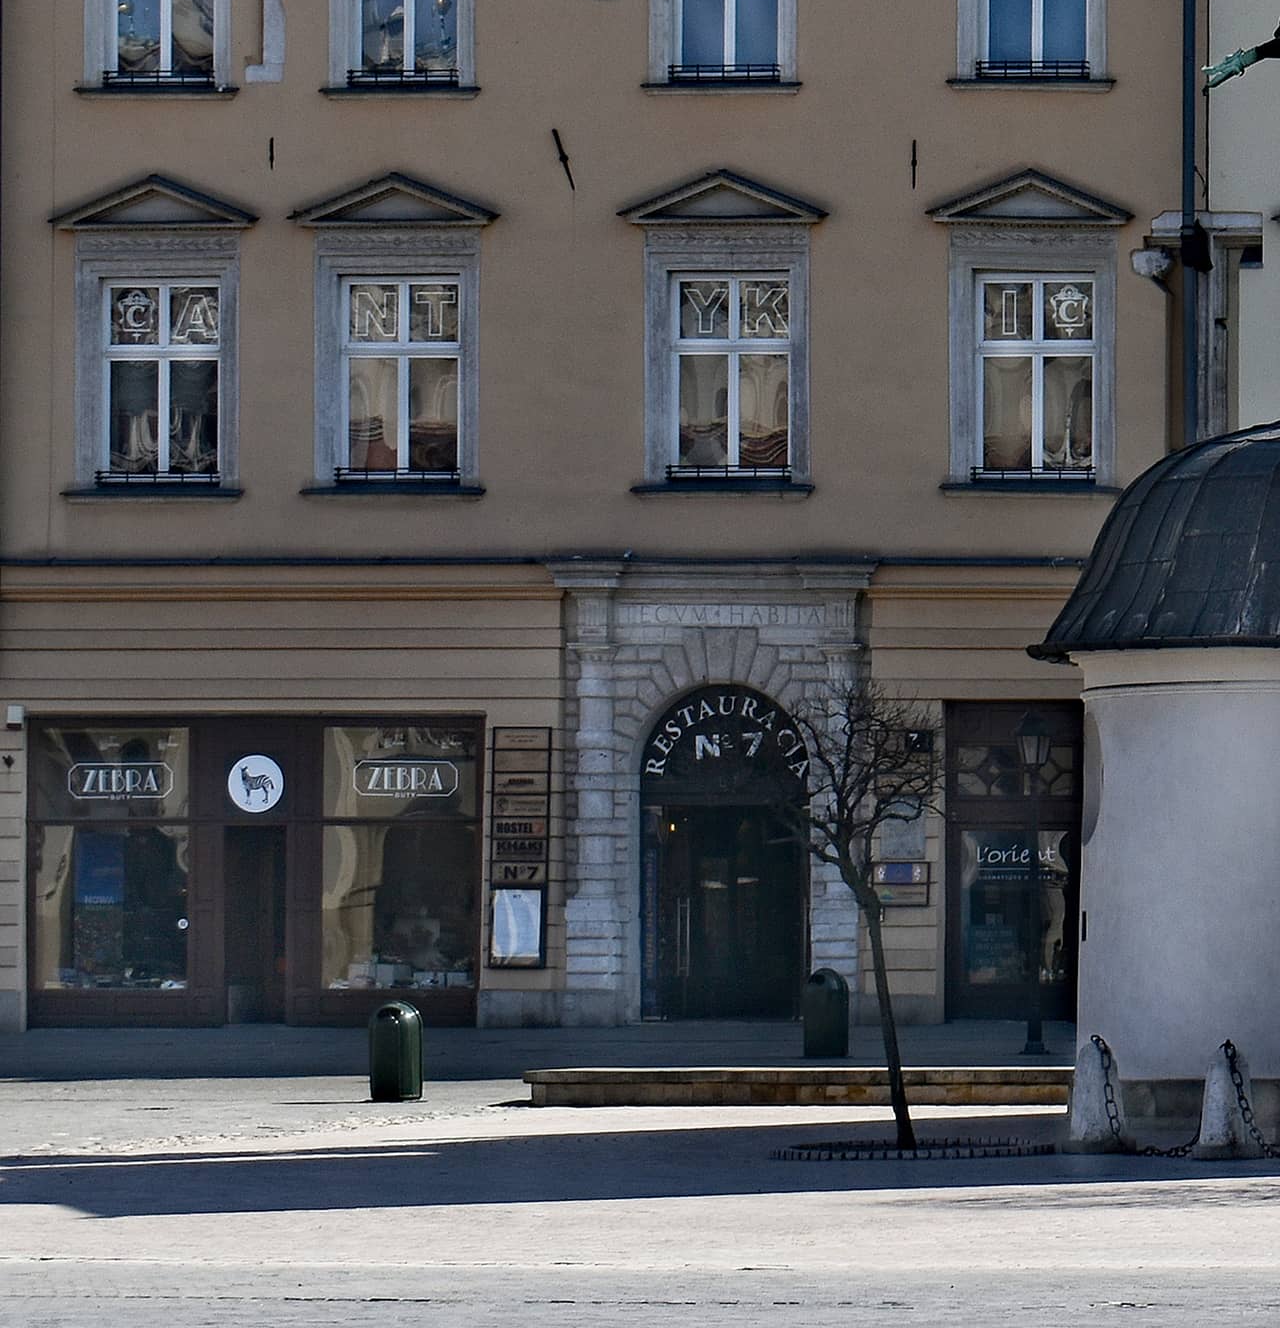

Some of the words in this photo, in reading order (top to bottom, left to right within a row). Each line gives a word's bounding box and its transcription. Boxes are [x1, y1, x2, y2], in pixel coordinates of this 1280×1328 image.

[82, 768, 158, 792] ZEBRA
[367, 767, 443, 790] ZEBRA
[496, 822, 533, 834] HOSTEL
